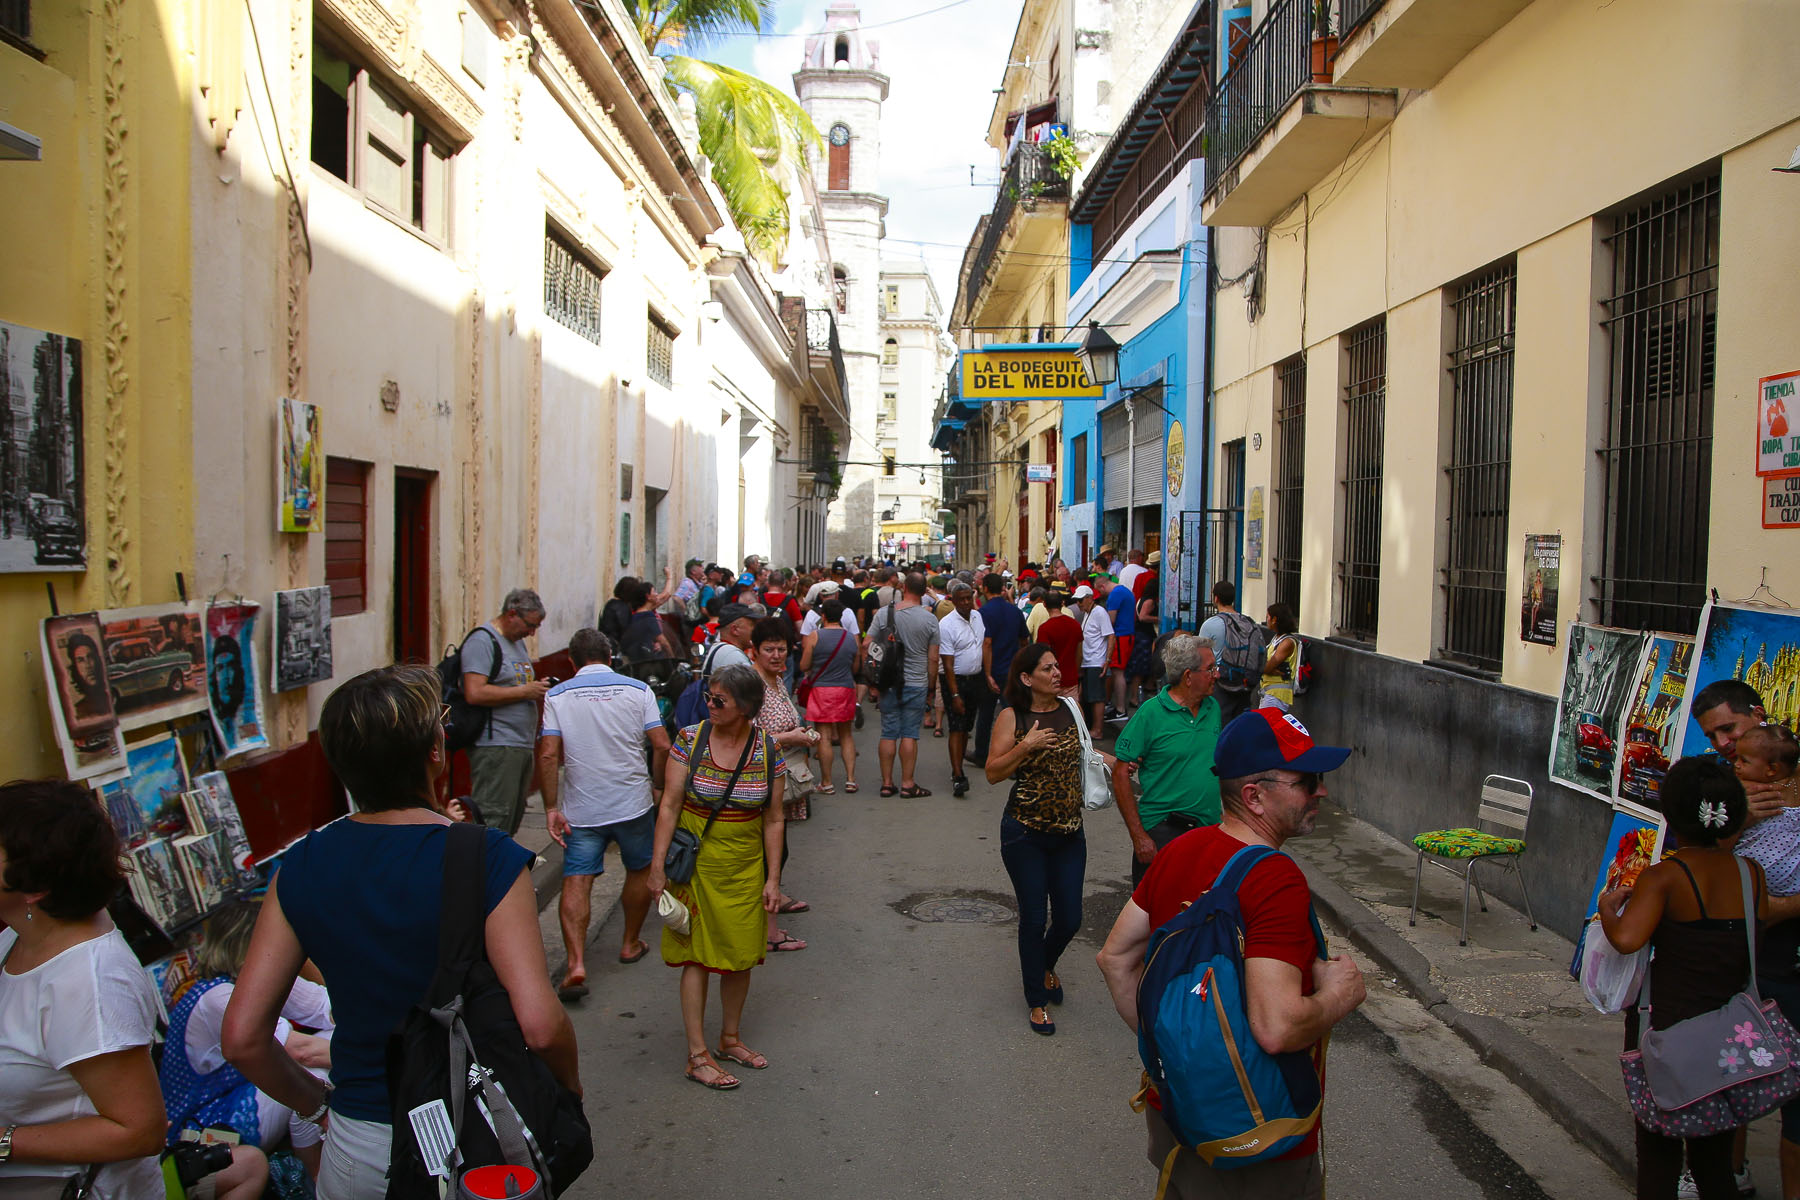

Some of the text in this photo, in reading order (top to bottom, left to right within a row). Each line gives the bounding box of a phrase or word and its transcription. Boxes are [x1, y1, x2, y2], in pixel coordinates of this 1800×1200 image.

[974, 361, 993, 373] LA
[974, 375, 1015, 388] DEL
[1764, 381, 1795, 400] TIENDA
[1762, 438, 1783, 454] ROPA
[1783, 451, 1800, 467] CUB
[1785, 477, 1800, 491] CU
[1769, 493, 1800, 507] TRAD
[1781, 508, 1800, 522] CLO
[1222, 1138, 1260, 1152] Quechua
